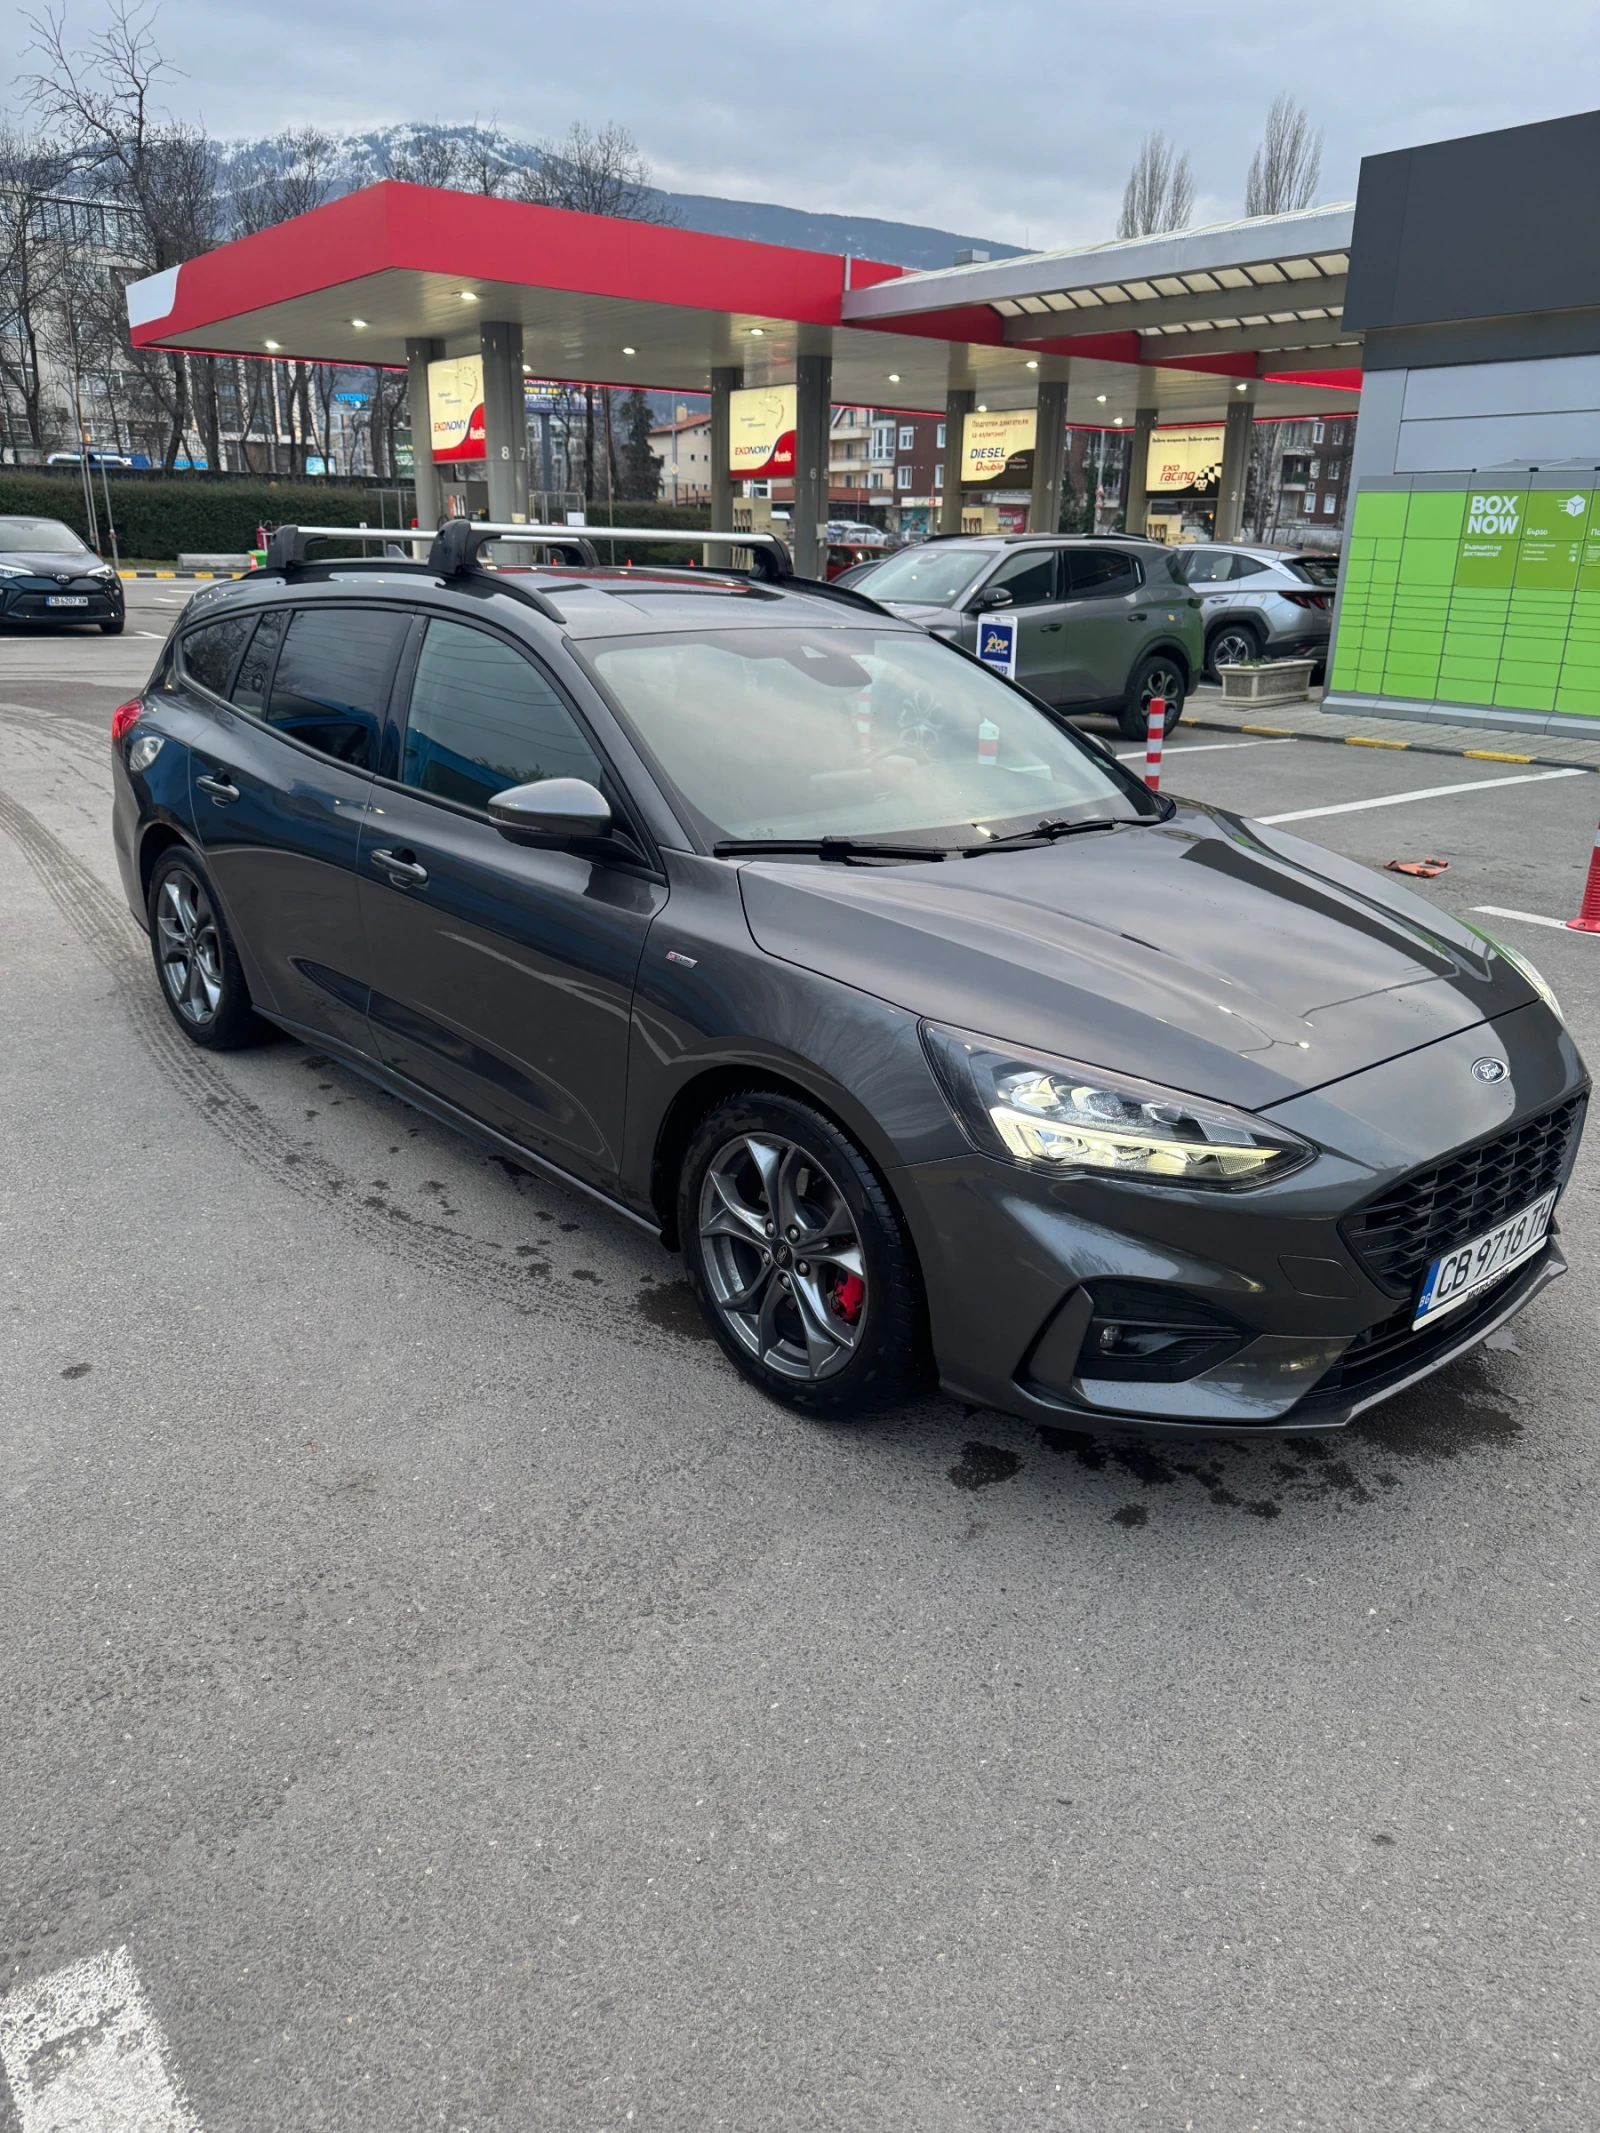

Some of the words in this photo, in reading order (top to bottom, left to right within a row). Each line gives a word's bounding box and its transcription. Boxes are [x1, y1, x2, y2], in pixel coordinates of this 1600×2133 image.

[434, 421, 466, 432] EKONOMY
[469, 427, 486, 440] fuels
[501, 446, 510, 460] 8
[519, 447, 526, 460] 7
[735, 445, 771, 455] EKONOMY
[774, 450, 792, 462] fuels
[970, 447, 1006, 459] DIESEL
[975, 461, 1004, 472] Double
[1162, 464, 1180, 472] EKO
[809, 468, 817, 480] 6
[1160, 471, 1196, 484] racing
[1231, 491, 1238, 501] 2
[1470, 495, 1519, 515] BOX
[1467, 515, 1519, 534] NOW
[984, 637, 1009, 652] TOP
[1480, 1063, 1502, 1080] Ford
[1418, 1292, 1432, 1308] BG
[1436, 1249, 1473, 1298] CB
[1473, 1216, 1528, 1278] 9718
[1527, 1194, 1555, 1243] TH
